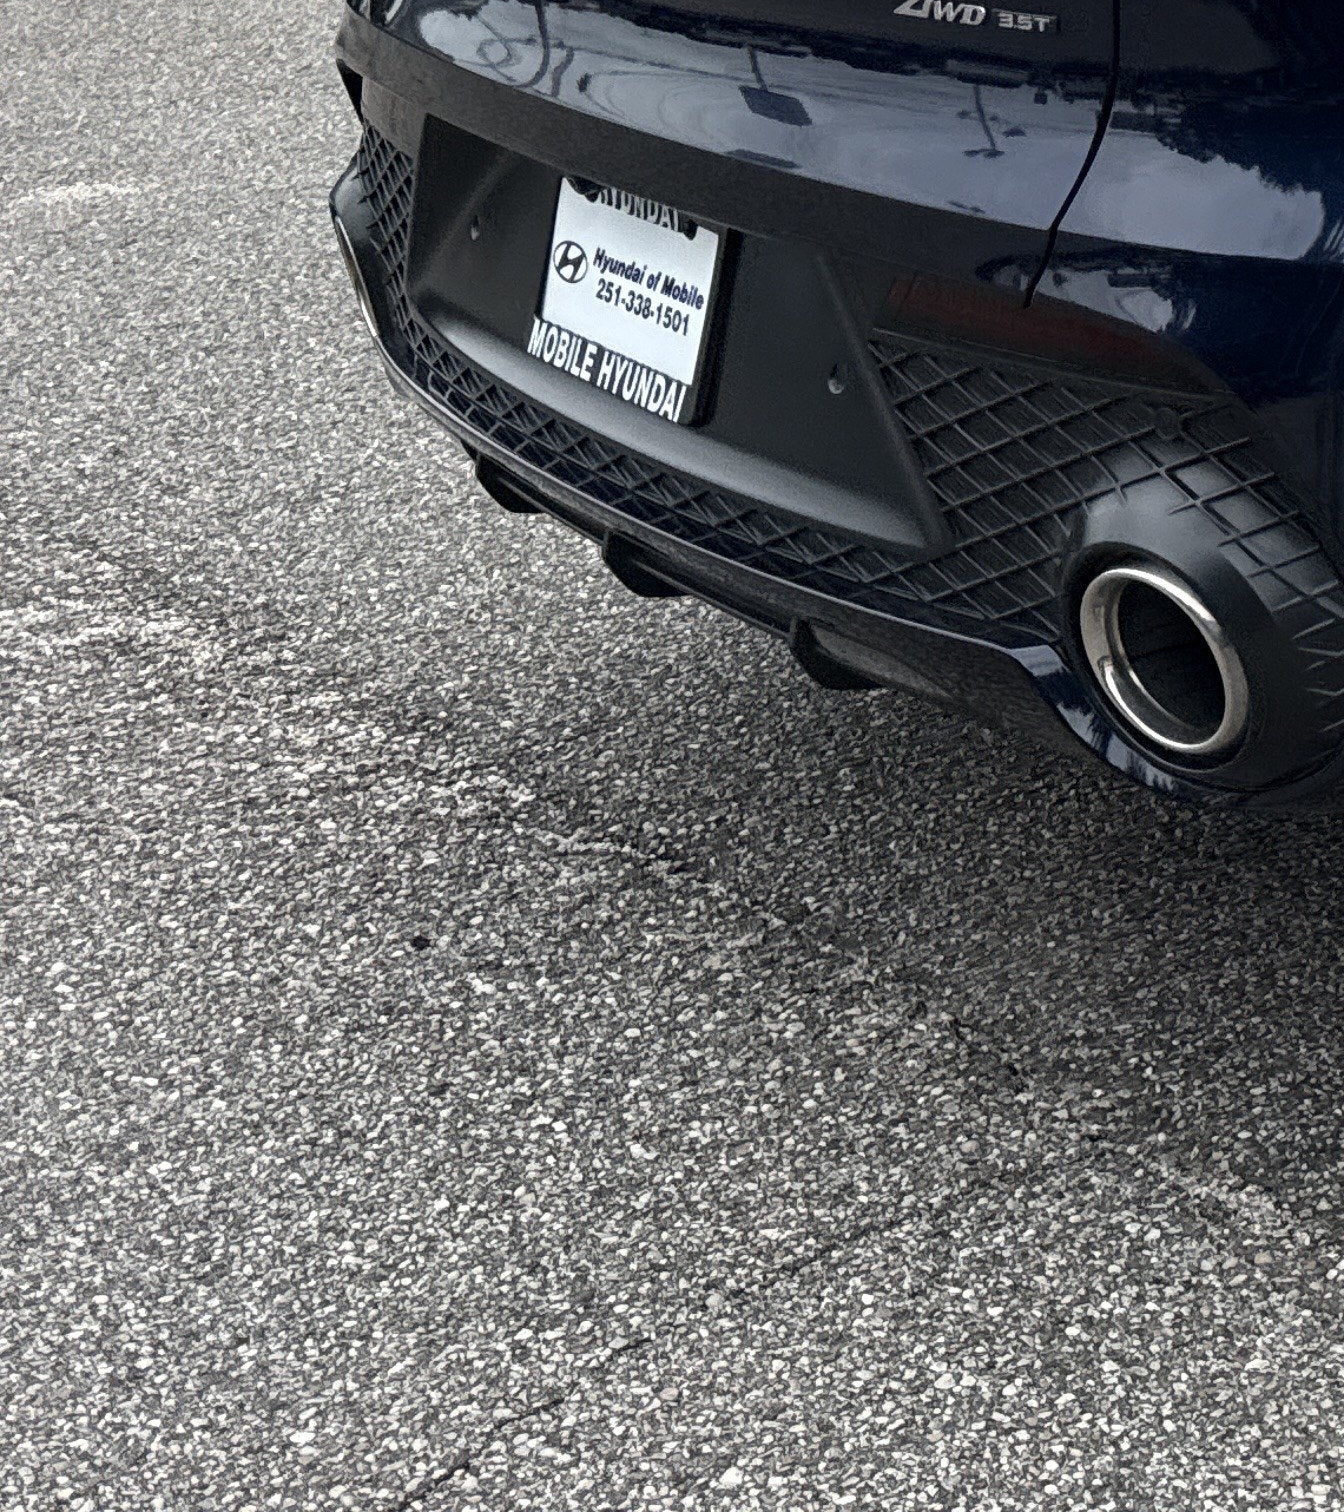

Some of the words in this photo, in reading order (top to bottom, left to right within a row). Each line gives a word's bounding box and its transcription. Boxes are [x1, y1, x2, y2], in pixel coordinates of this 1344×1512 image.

[592, 246, 648, 286] Hyundai
[646, 270, 663, 293] of
[660, 274, 705, 311] Mobile
[595, 277, 690, 337] 251-338-1501
[527, 316, 599, 383] MOBILE
[596, 349, 688, 423] HYUNDAI
